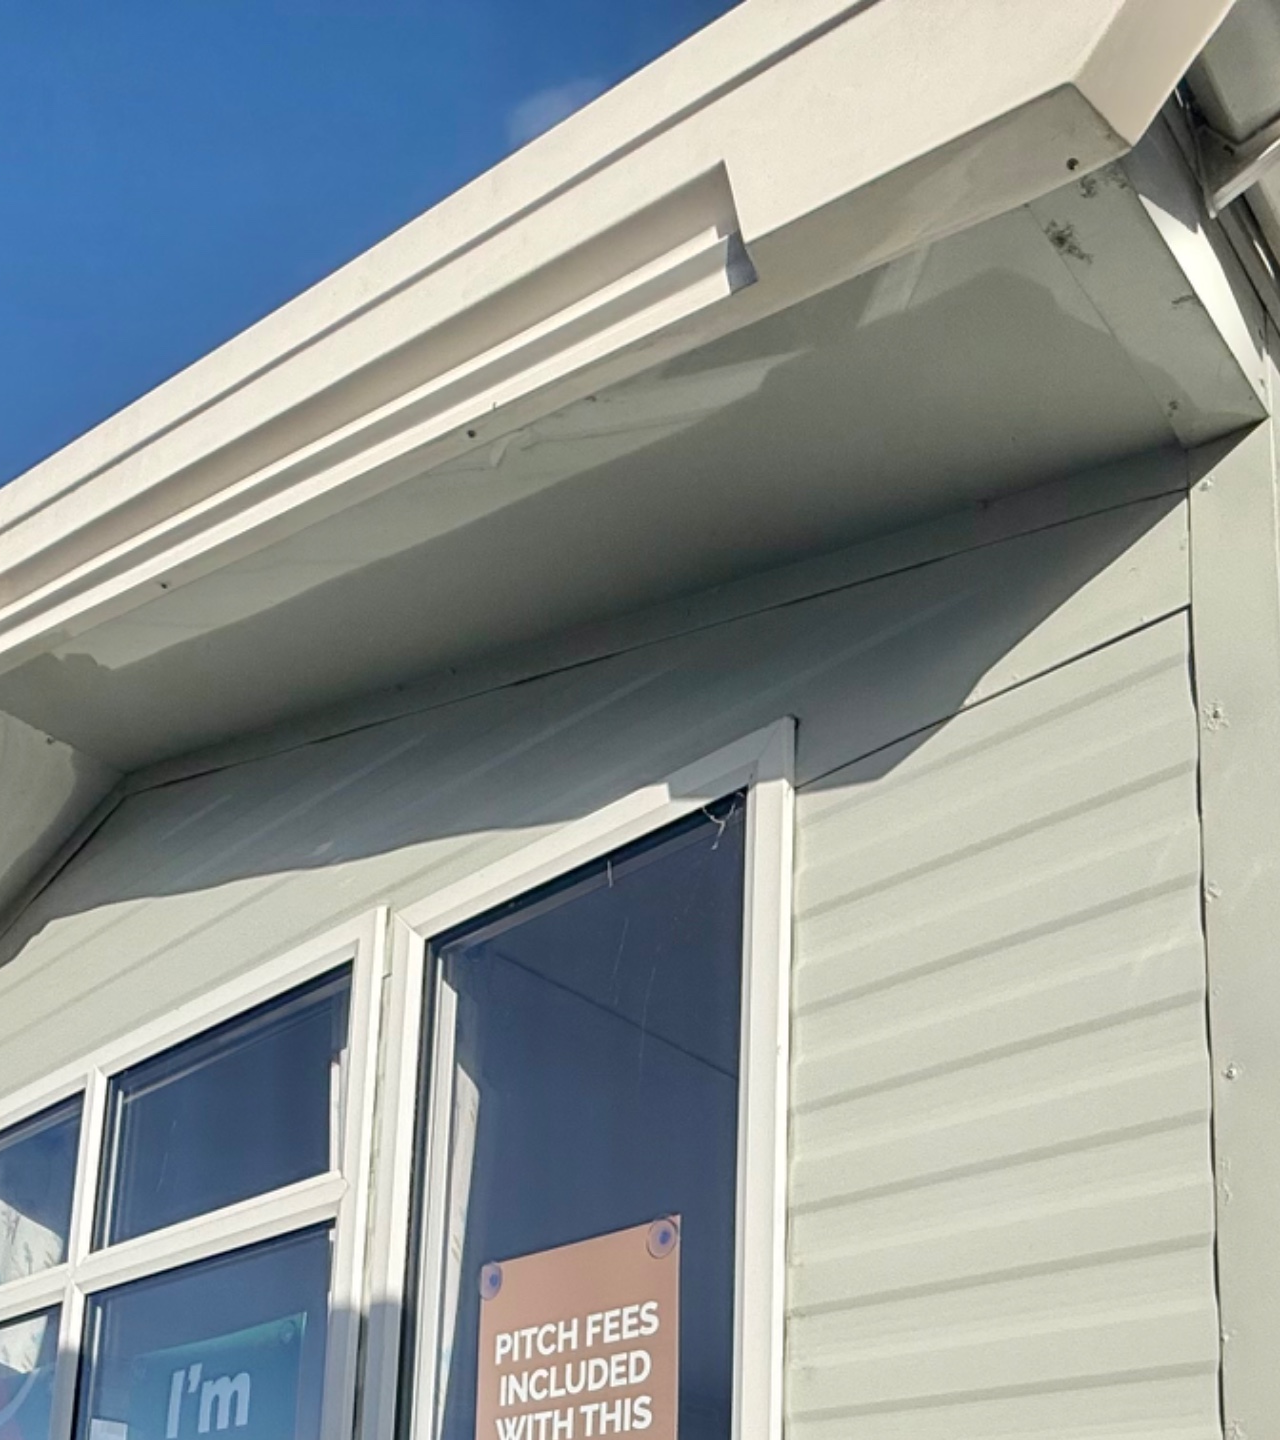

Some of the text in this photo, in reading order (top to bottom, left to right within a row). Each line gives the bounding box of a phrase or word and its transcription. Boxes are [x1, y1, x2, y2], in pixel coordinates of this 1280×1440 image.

[495, 1301, 660, 1366] PITCH FEES
[166, 1362, 251, 1439] I'm
[500, 1350, 652, 1407] INCLUDED
[580, 1395, 653, 1437] THIS
